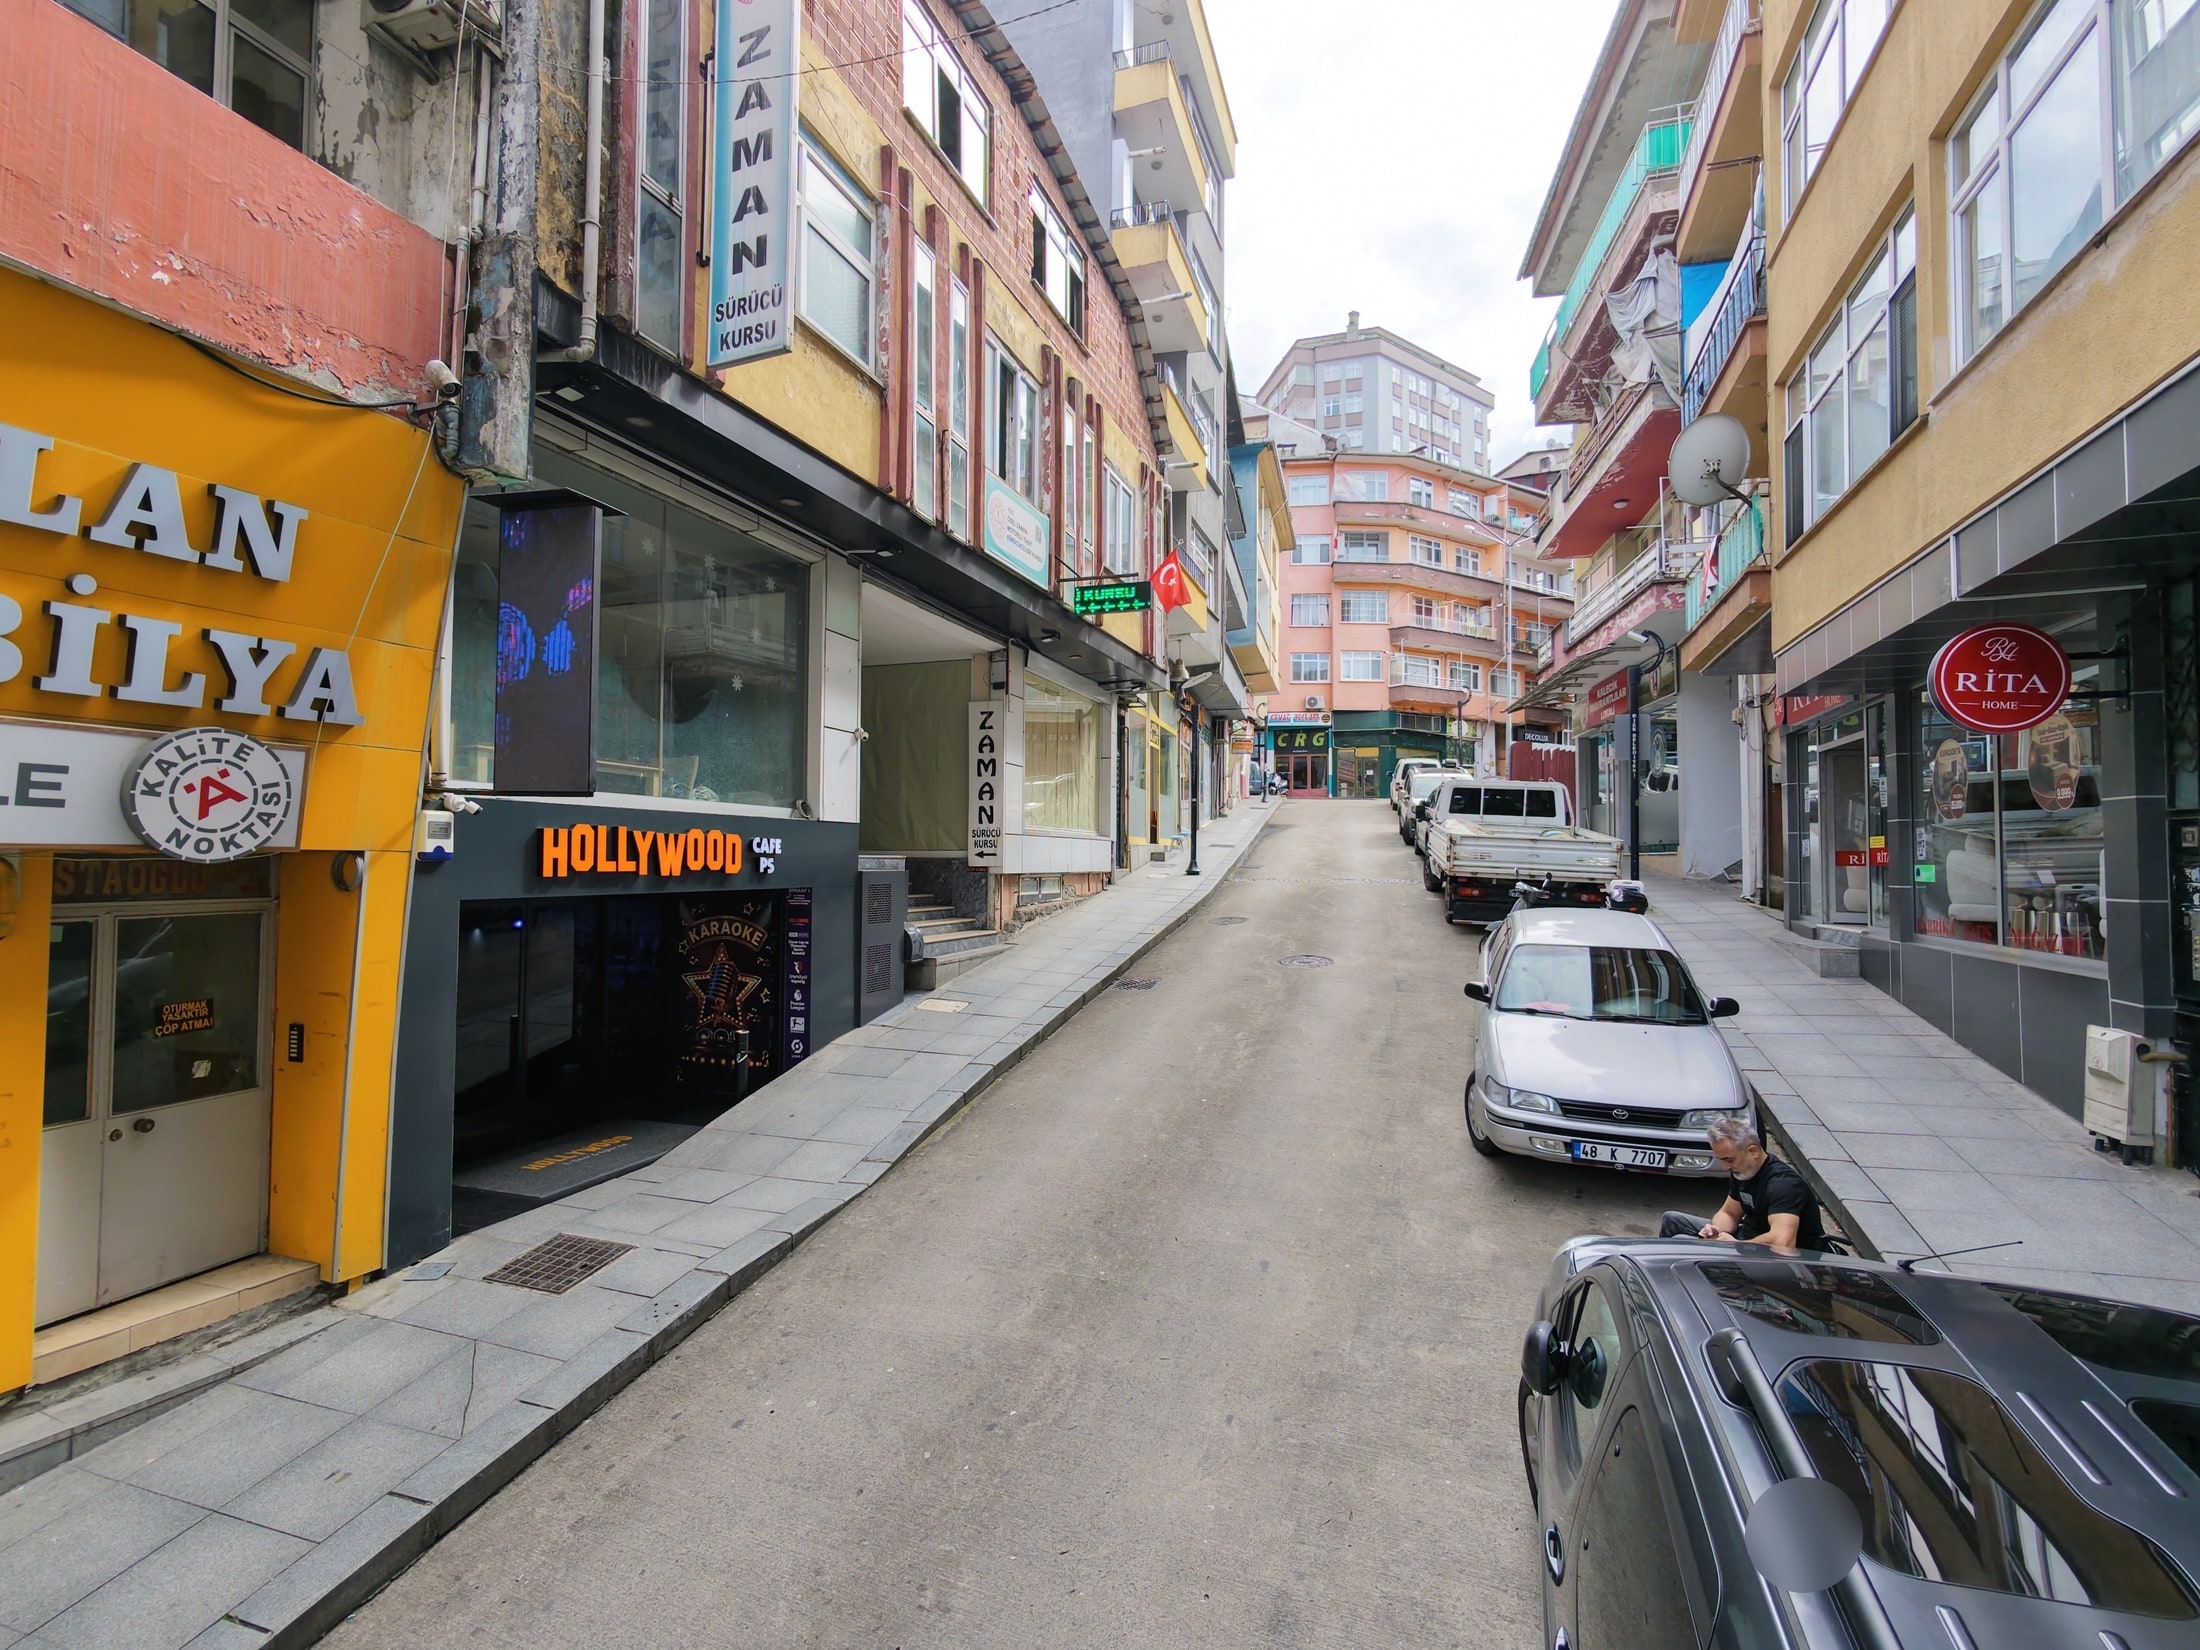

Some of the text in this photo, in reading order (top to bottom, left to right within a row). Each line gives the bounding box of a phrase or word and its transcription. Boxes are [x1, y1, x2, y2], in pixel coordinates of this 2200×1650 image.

[732, 24, 773, 275] ZAMAN
[715, 284, 783, 324] SÜRÜCÜ
[719, 322, 777, 353] KURSU
[1083, 586, 1136, 602] KURSU
[1954, 668, 2049, 694] RİTA
[1982, 700, 2019, 711] HOME
[976, 711, 997, 825] ZAMAN
[0, 761, 70, 809] E
[164, 781, 283, 855] NOKTASI
[971, 827, 1001, 838] SÜRÜCÜ
[974, 839, 998, 849] KURSU
[541, 823, 743, 878] HOLLYWOOD
[752, 837, 782, 855] CAFE
[1876, 850, 1890, 864] RİT
[688, 920, 765, 947] KARAOKE
[162, 1000, 208, 1014] OTURMAK
[162, 1008, 209, 1022] YASAKTIR
[521, 1135, 634, 1172] HOLLYWOOD
[1581, 1144, 1665, 1166] 48 K 7707
